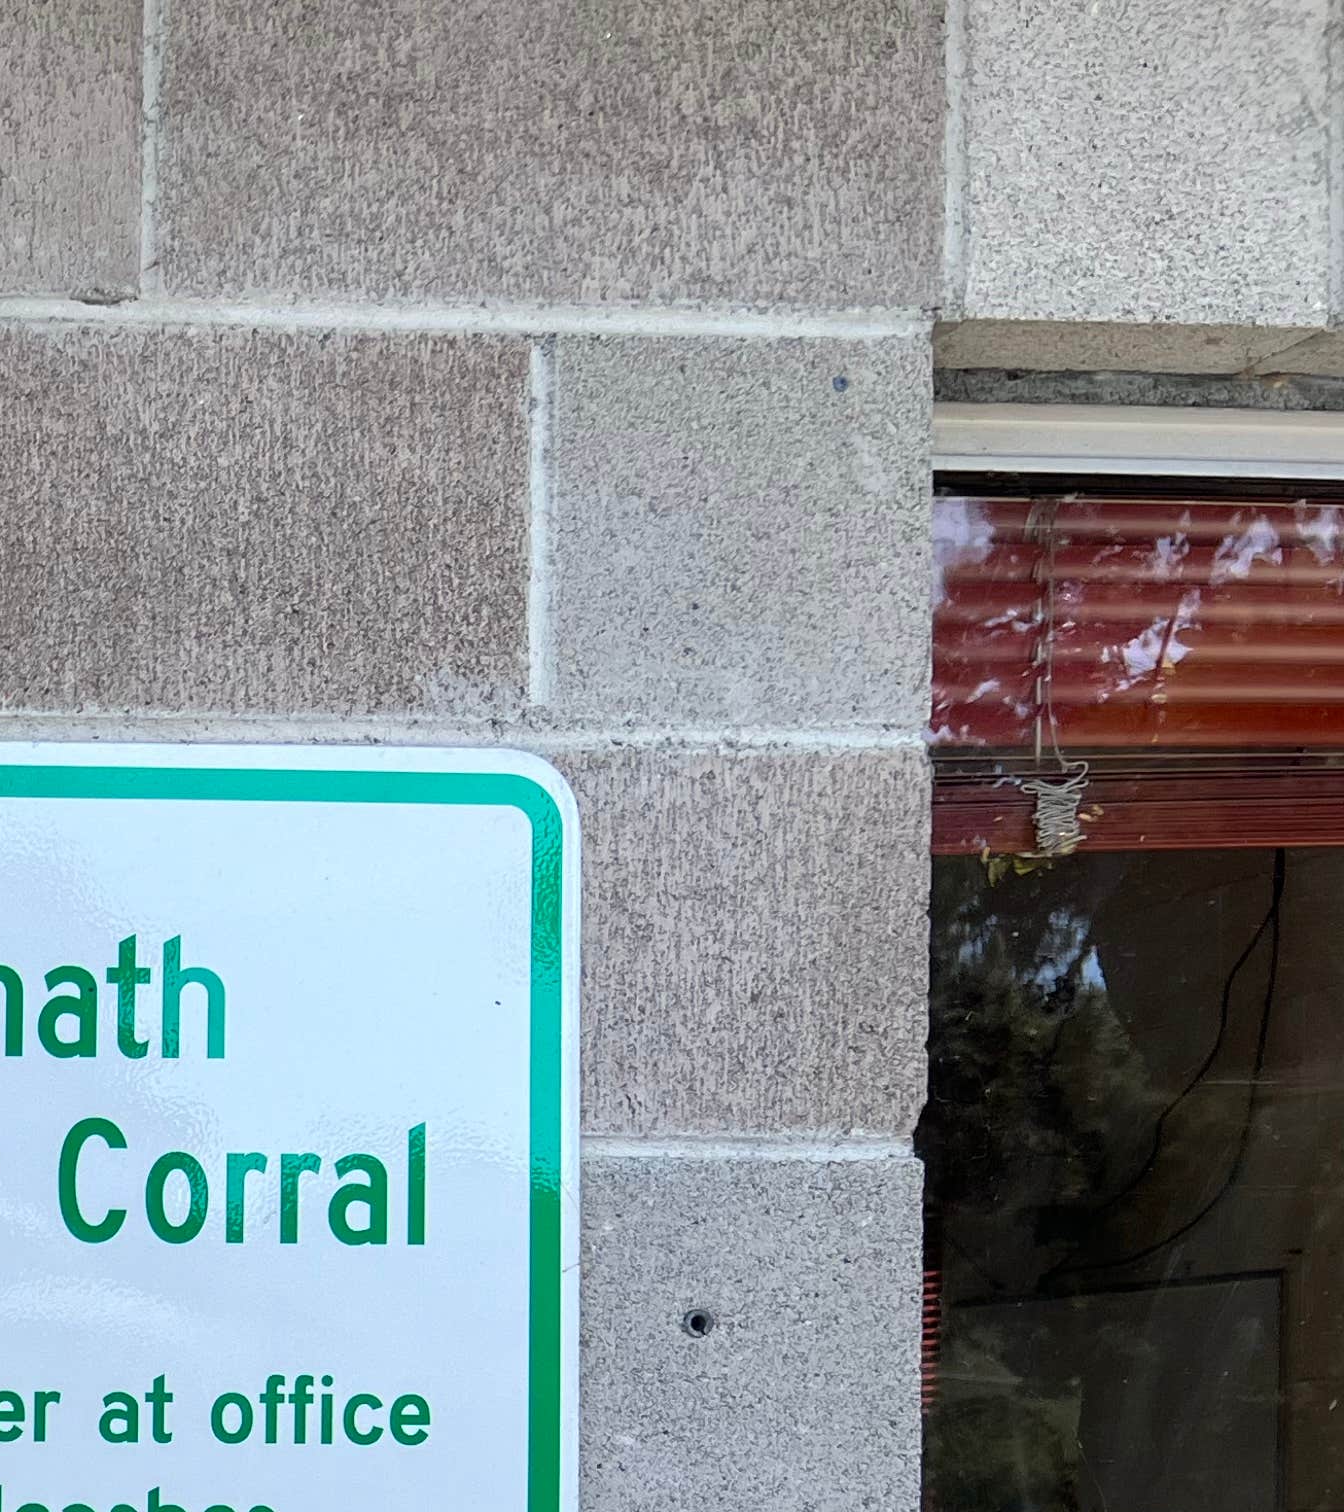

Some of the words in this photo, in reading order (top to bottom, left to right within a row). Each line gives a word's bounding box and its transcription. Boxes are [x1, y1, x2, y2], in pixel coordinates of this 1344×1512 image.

[56, 1115, 428, 1248] Corral
[97, 1372, 176, 1446] at
[209, 1372, 432, 1448] office
